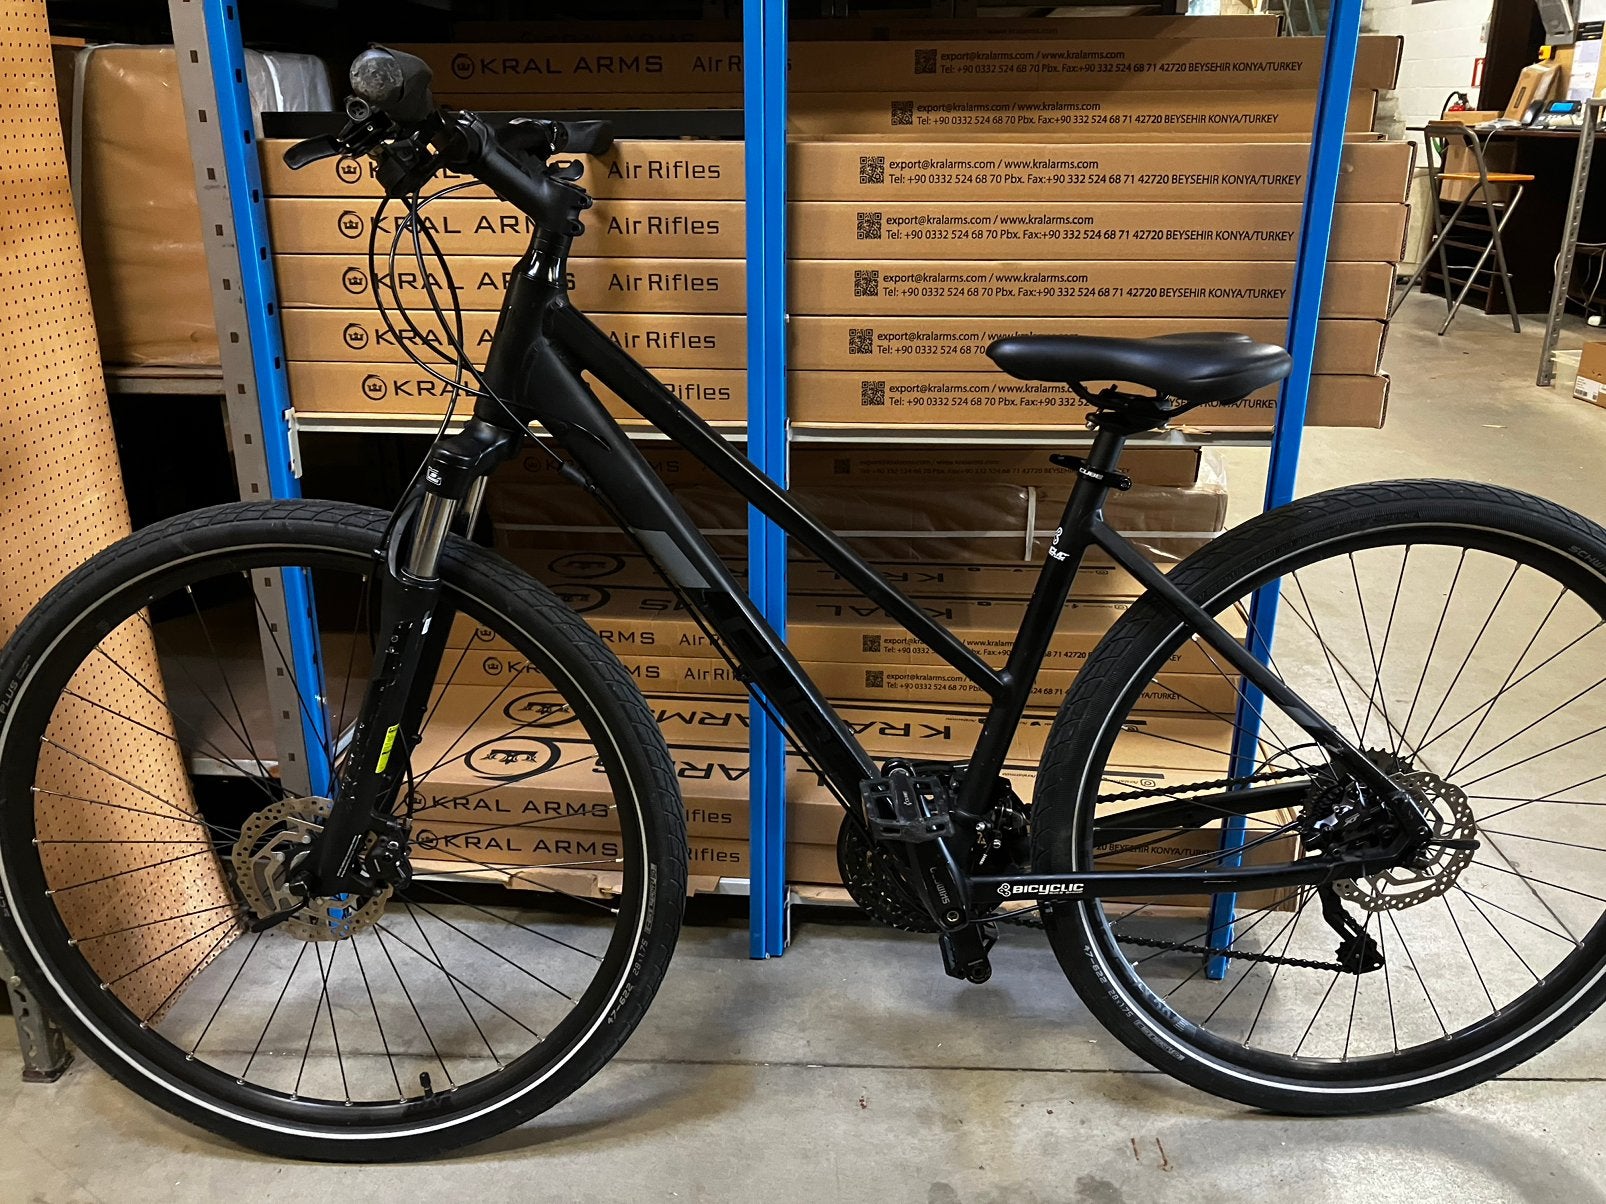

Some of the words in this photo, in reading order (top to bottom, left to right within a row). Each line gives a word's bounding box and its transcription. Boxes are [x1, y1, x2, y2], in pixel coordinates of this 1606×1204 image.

[481, 57, 562, 74] KRAL
[573, 55, 664, 74] ARMS
[692, 56, 722, 73] Air
[917, 102, 1009, 114] export@kralarms.com
[1017, 102, 1099, 111] www.kralarms.com
[916, 116, 930, 125] Tel:
[933, 116, 949, 125] +90
[951, 116, 972, 125] 0332
[974, 115, 990, 125] 524
[992, 115, 1003, 125] 68
[1005, 115, 1015, 125] 70
[1017, 115, 1035, 125] Pbx.
[1072, 115, 1088, 125] 332
[1091, 115, 1106, 125] 524
[1108, 114, 1120, 125] 68
[1122, 114, 1131, 125] 71
[1134, 114, 1162, 125] 42720
[1164, 114, 1206, 125] BEYSEHIR
[1208, 114, 1278, 125] KONYA/TURKEY
[608, 161, 642, 178] Air
[648, 160, 720, 179] Rifles
[889, 159, 994, 171] export@kralarms.com
[1004, 159, 1098, 169] www.kralarms.com
[888, 173, 904, 183] Tel:
[907, 173, 926, 183] +90
[928, 173, 952, 183] 0332
[954, 173, 972, 183] 524
[975, 173, 987, 183] 68
[990, 173, 1001, 183] 70
[1004, 173, 1024, 183] Pbx.
[1067, 174, 1085, 183] 332
[1088, 174, 1106, 183] 524
[1108, 174, 1120, 183] 68
[1123, 174, 1134, 183] 71
[1138, 174, 1169, 183] 42720
[1171, 174, 1218, 184] BEYSEHIR
[1221, 174, 1300, 184] KONYA/TURKEY
[371, 216, 461, 234] KRAL
[608, 216, 642, 234] Air
[648, 216, 720, 234] Rifles
[886, 215, 990, 226] export@kralarms.com
[1000, 215, 1092, 225] www.kralarms.com
[886, 228, 902, 238] Tel:
[904, 228, 922, 238] +90
[925, 228, 948, 238] 0332
[951, 228, 968, 238] 524
[971, 228, 983, 239] 68
[986, 229, 997, 239] 70
[1000, 229, 1020, 239] Pbx.
[1062, 229, 1080, 239] 332
[1082, 229, 1101, 239] 524
[1103, 229, 1115, 239] 68
[1118, 229, 1128, 239] 71
[1132, 229, 1163, 239] 42720
[1165, 230, 1212, 239] BEYSEHIR
[1215, 230, 1294, 240] KONYA/TURKEY
[375, 273, 464, 290] KRAL
[608, 274, 642, 291] Air
[648, 274, 718, 291] Rifles
[883, 273, 986, 284] export@kralarms.com
[995, 273, 1087, 283] www.kralarms.com
[882, 286, 898, 295] Tel:
[901, 286, 919, 295] +90
[921, 286, 944, 296] 0332
[947, 287, 964, 296] 524
[966, 287, 978, 296] 68
[981, 287, 992, 296] 70
[995, 287, 1015, 296] Pbx.
[1057, 287, 1075, 296] 332
[1077, 287, 1095, 296] 524
[1097, 287, 1109, 297] 68
[1112, 287, 1122, 297] 71
[1126, 287, 1156, 297] 42720
[1159, 287, 1205, 297] BEYSEHIR
[1208, 288, 1286, 297] KONYA/TURKEY
[376, 329, 460, 346] KRAL
[610, 332, 640, 348] Air
[646, 332, 716, 348] Rifles
[878, 332, 979, 342] export@kralarms.com
[878, 346, 892, 354] Tel:
[895, 346, 912, 354] +90
[915, 346, 937, 354] 0332
[941, 346, 957, 354] 524
[960, 346, 971, 354] 68
[974, 346, 985, 354] 70
[890, 384, 989, 394] export@kralarms.com
[998, 384, 1088, 393] www.kralarms.c
[890, 397, 904, 406] Tel:
[907, 397, 924, 406] +90
[927, 397, 949, 406] 0332
[952, 397, 968, 406] 524
[971, 397, 982, 406] 68
[985, 397, 995, 406] 70
[999, 397, 1017, 406] Pbx.
[1059, 397, 1075, 406] 332
[600, 630, 654, 644] RMS
[680, 633, 703, 646] Air
[685, 668, 709, 680] Air
[887, 674, 963, 683] export@kralarms.com
[1141, 692, 1180, 700] YA/TURKEY
[433, 796, 511, 812] KRAL
[522, 800, 608, 817] ARMS
[686, 810, 732, 824] ifles
[445, 835, 522, 852] KRAL
[534, 839, 618, 856] ARMS
[1012, 883, 1084, 894] BICYCLIC
